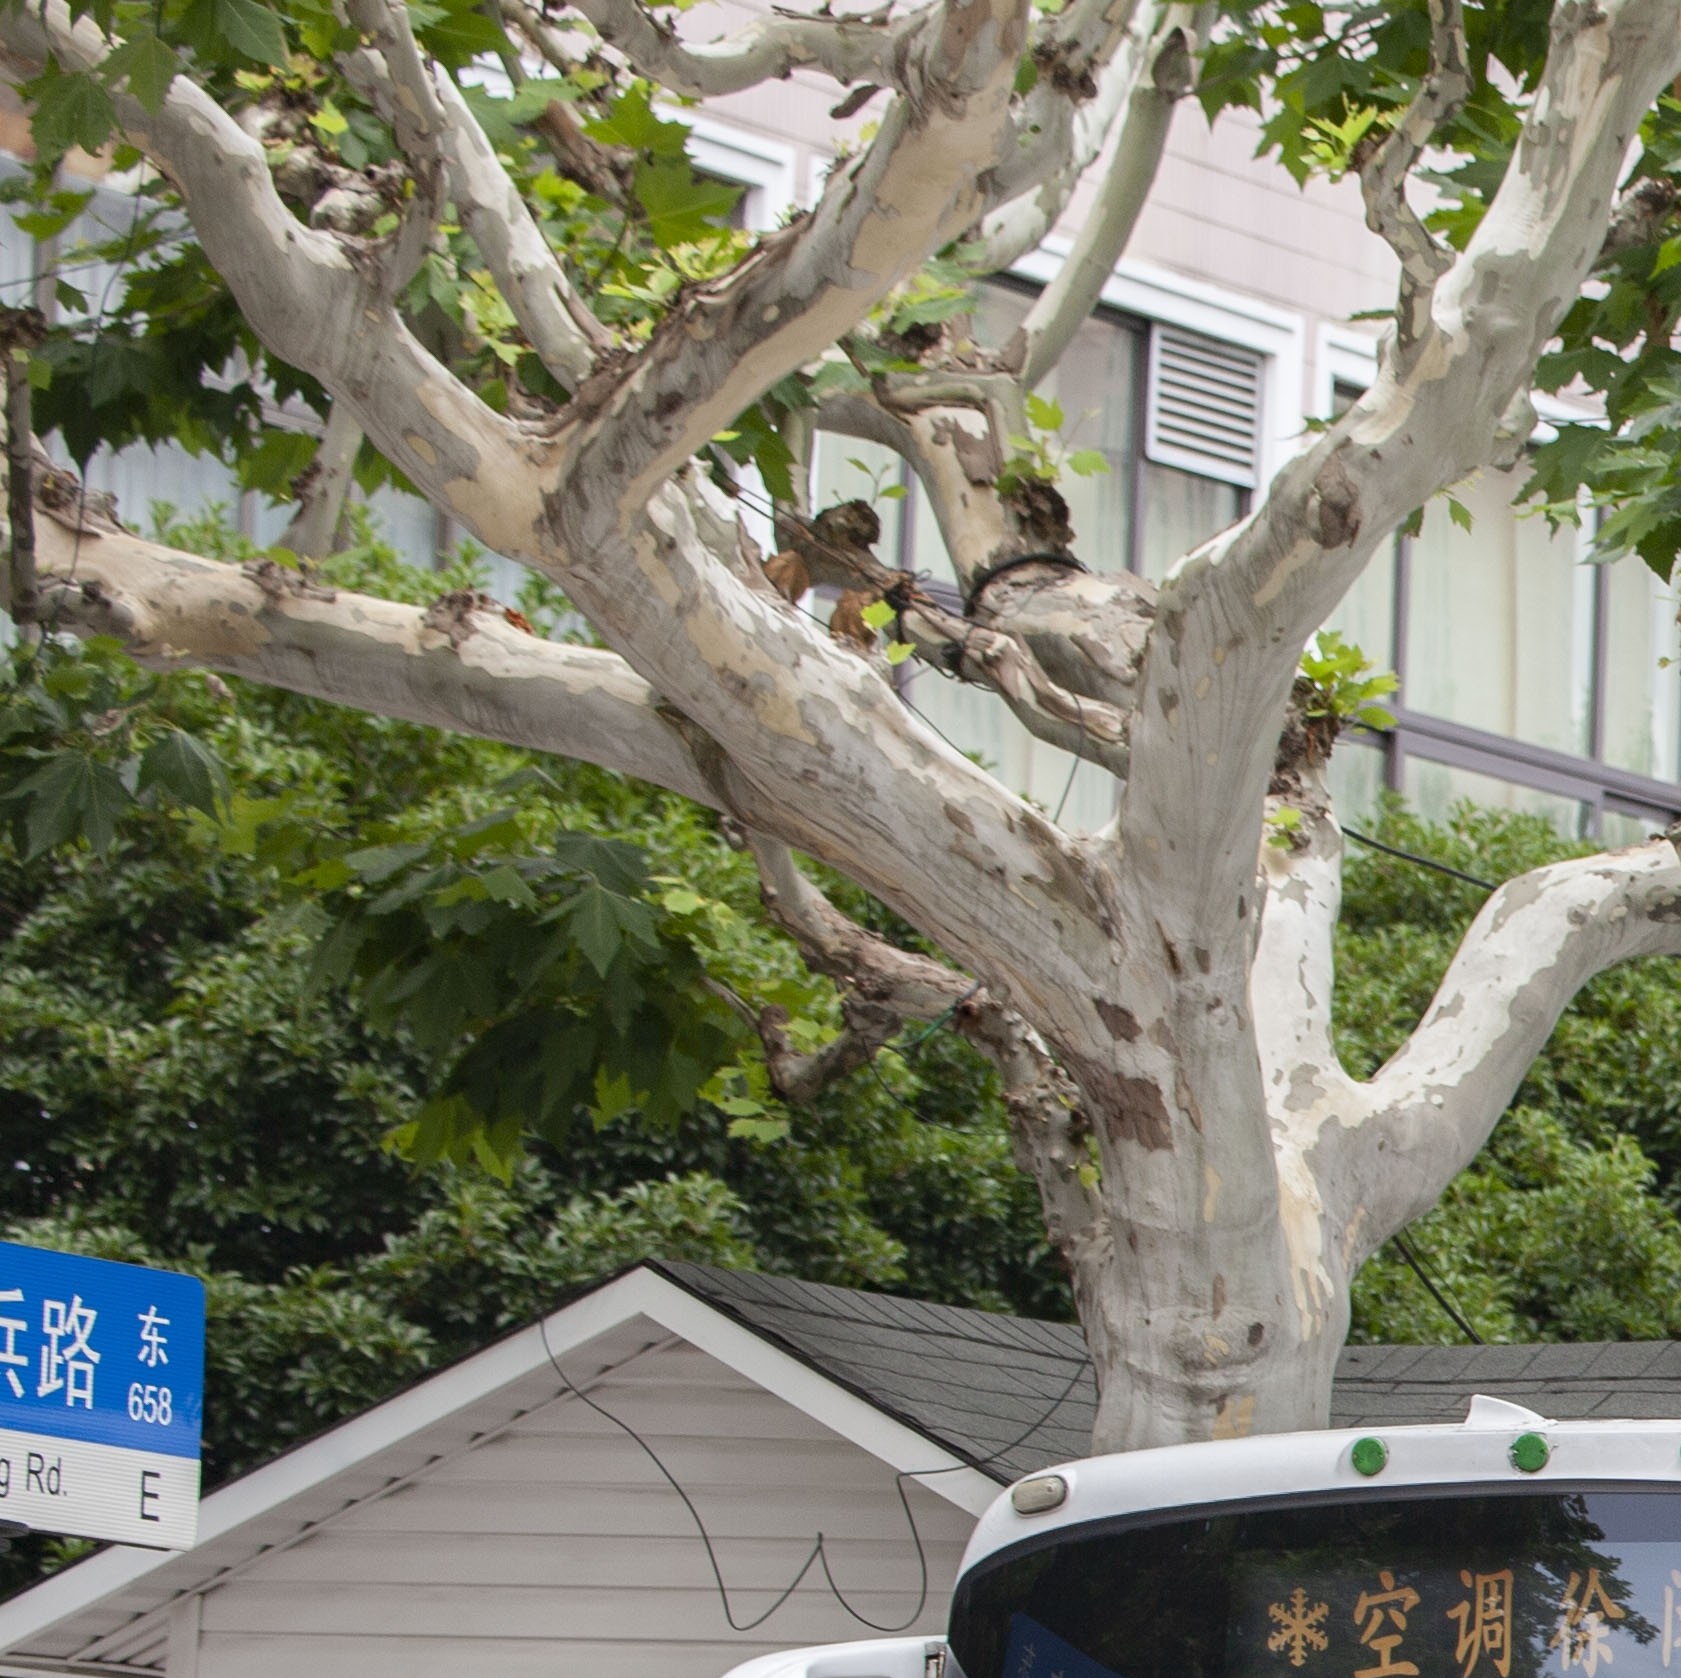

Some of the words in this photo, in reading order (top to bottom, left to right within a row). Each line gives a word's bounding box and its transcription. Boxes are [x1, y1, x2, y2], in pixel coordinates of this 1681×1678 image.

[138, 1304, 170, 1368] 东
[128, 1382, 172, 1426] 658
[26, 1451, 68, 1497] Rd.
[140, 1470, 161, 1522] E
